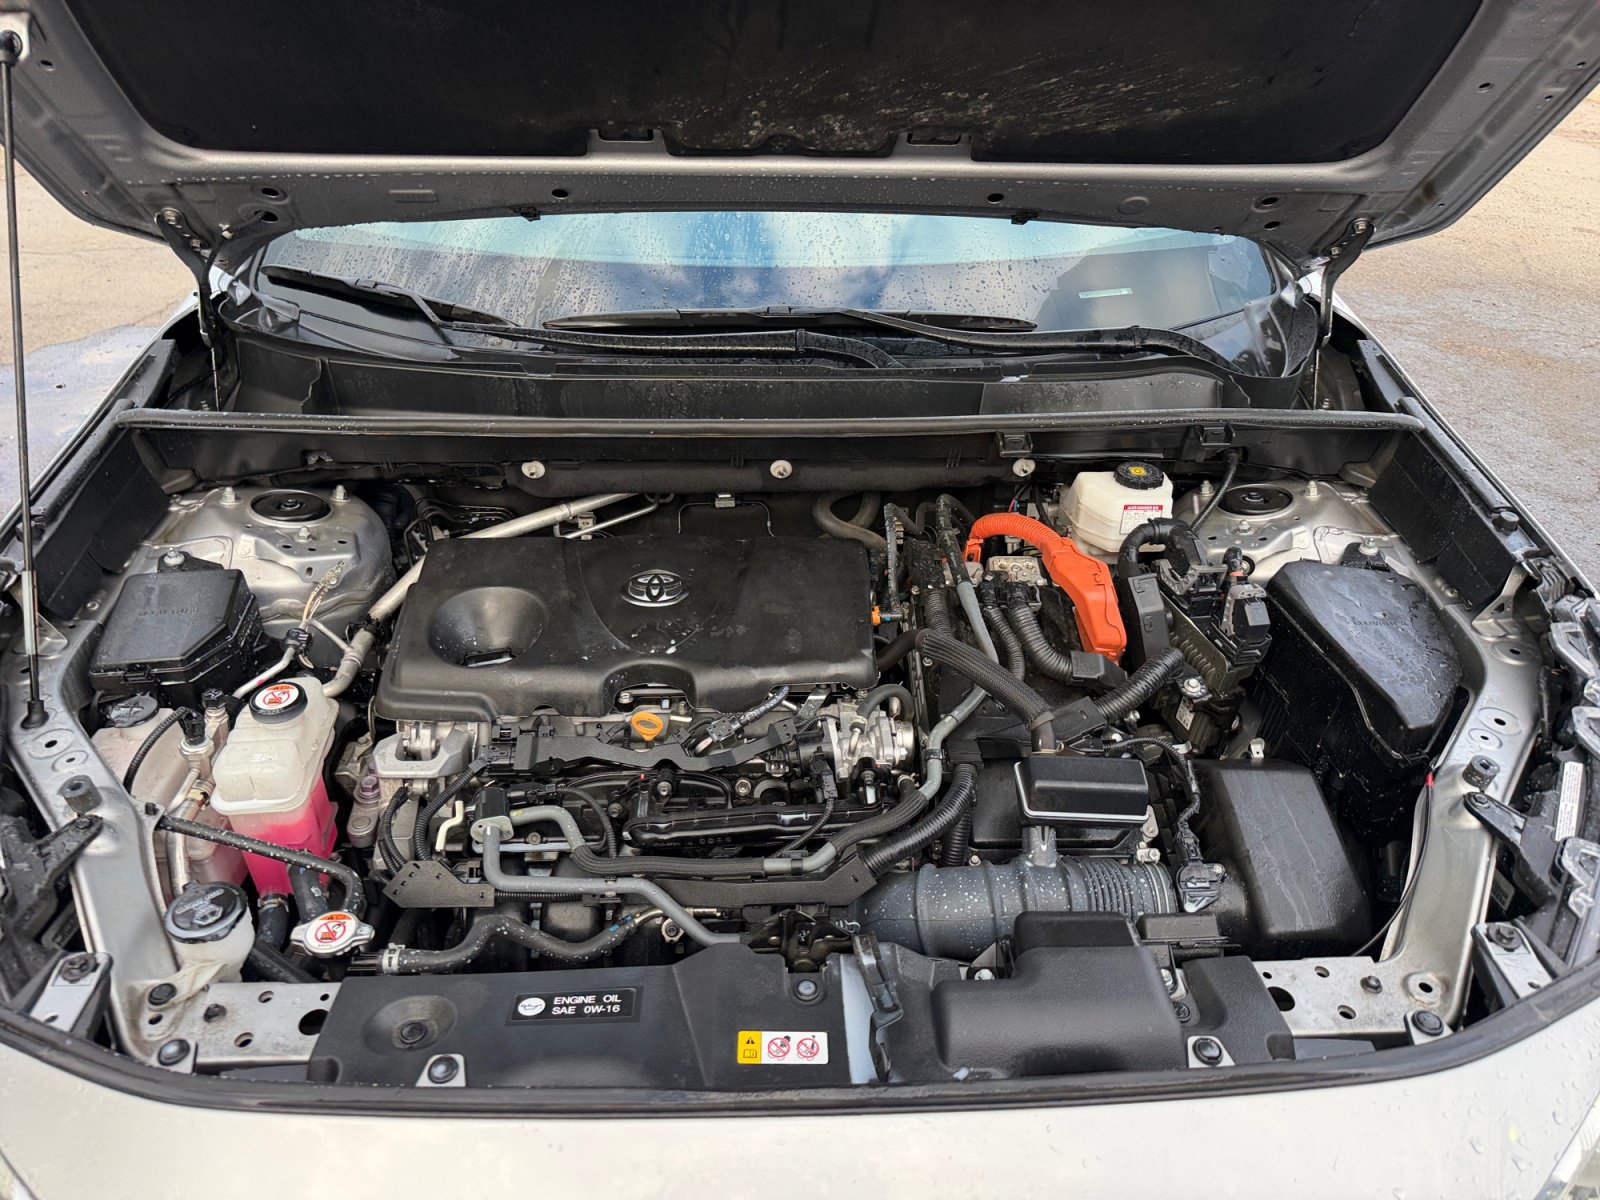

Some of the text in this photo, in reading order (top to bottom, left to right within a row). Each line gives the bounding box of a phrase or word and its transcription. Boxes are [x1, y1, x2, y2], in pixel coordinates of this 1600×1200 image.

[554, 994, 621, 1004] ENGINE OIL
[552, 1004, 620, 1014] SAE 0W-16
